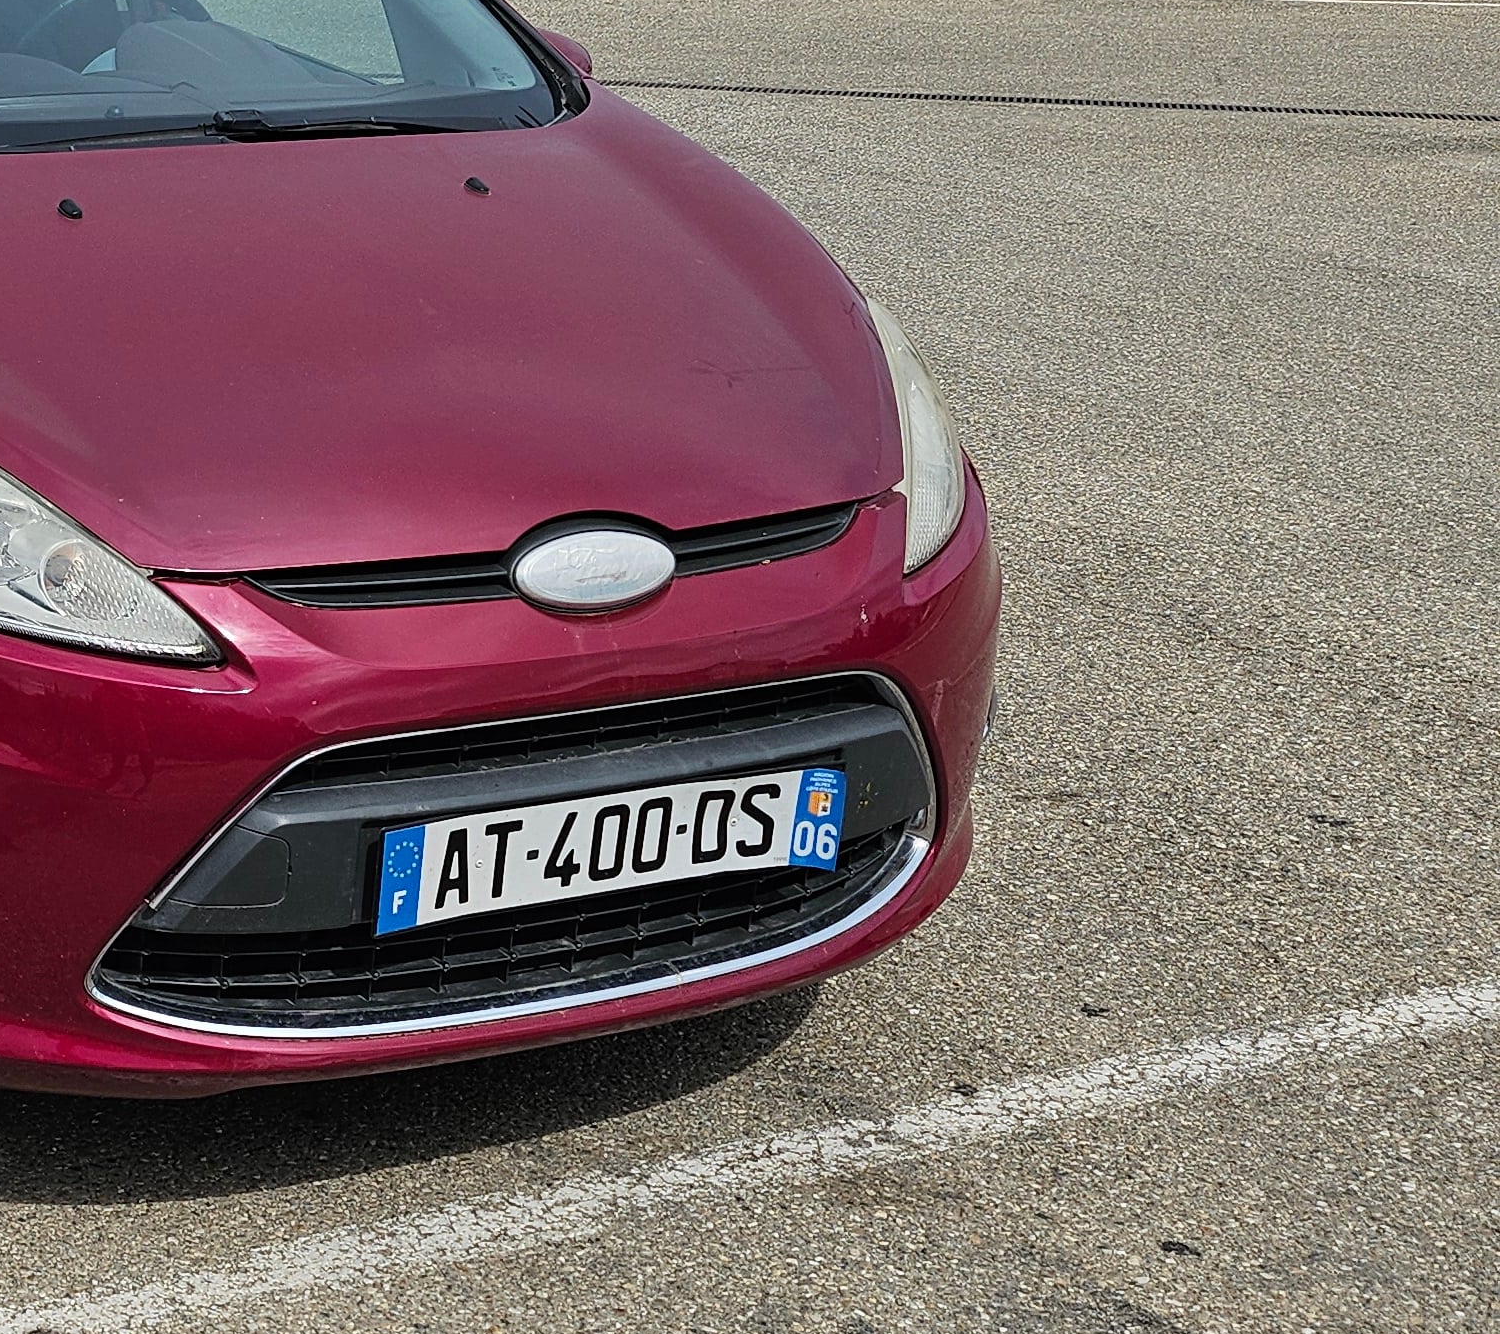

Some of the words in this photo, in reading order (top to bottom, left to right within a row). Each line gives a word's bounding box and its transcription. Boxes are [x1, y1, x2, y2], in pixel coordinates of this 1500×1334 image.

[392, 890, 407, 915] F
[434, 783, 782, 909] AT-400-DS
[793, 820, 838, 860] 06
